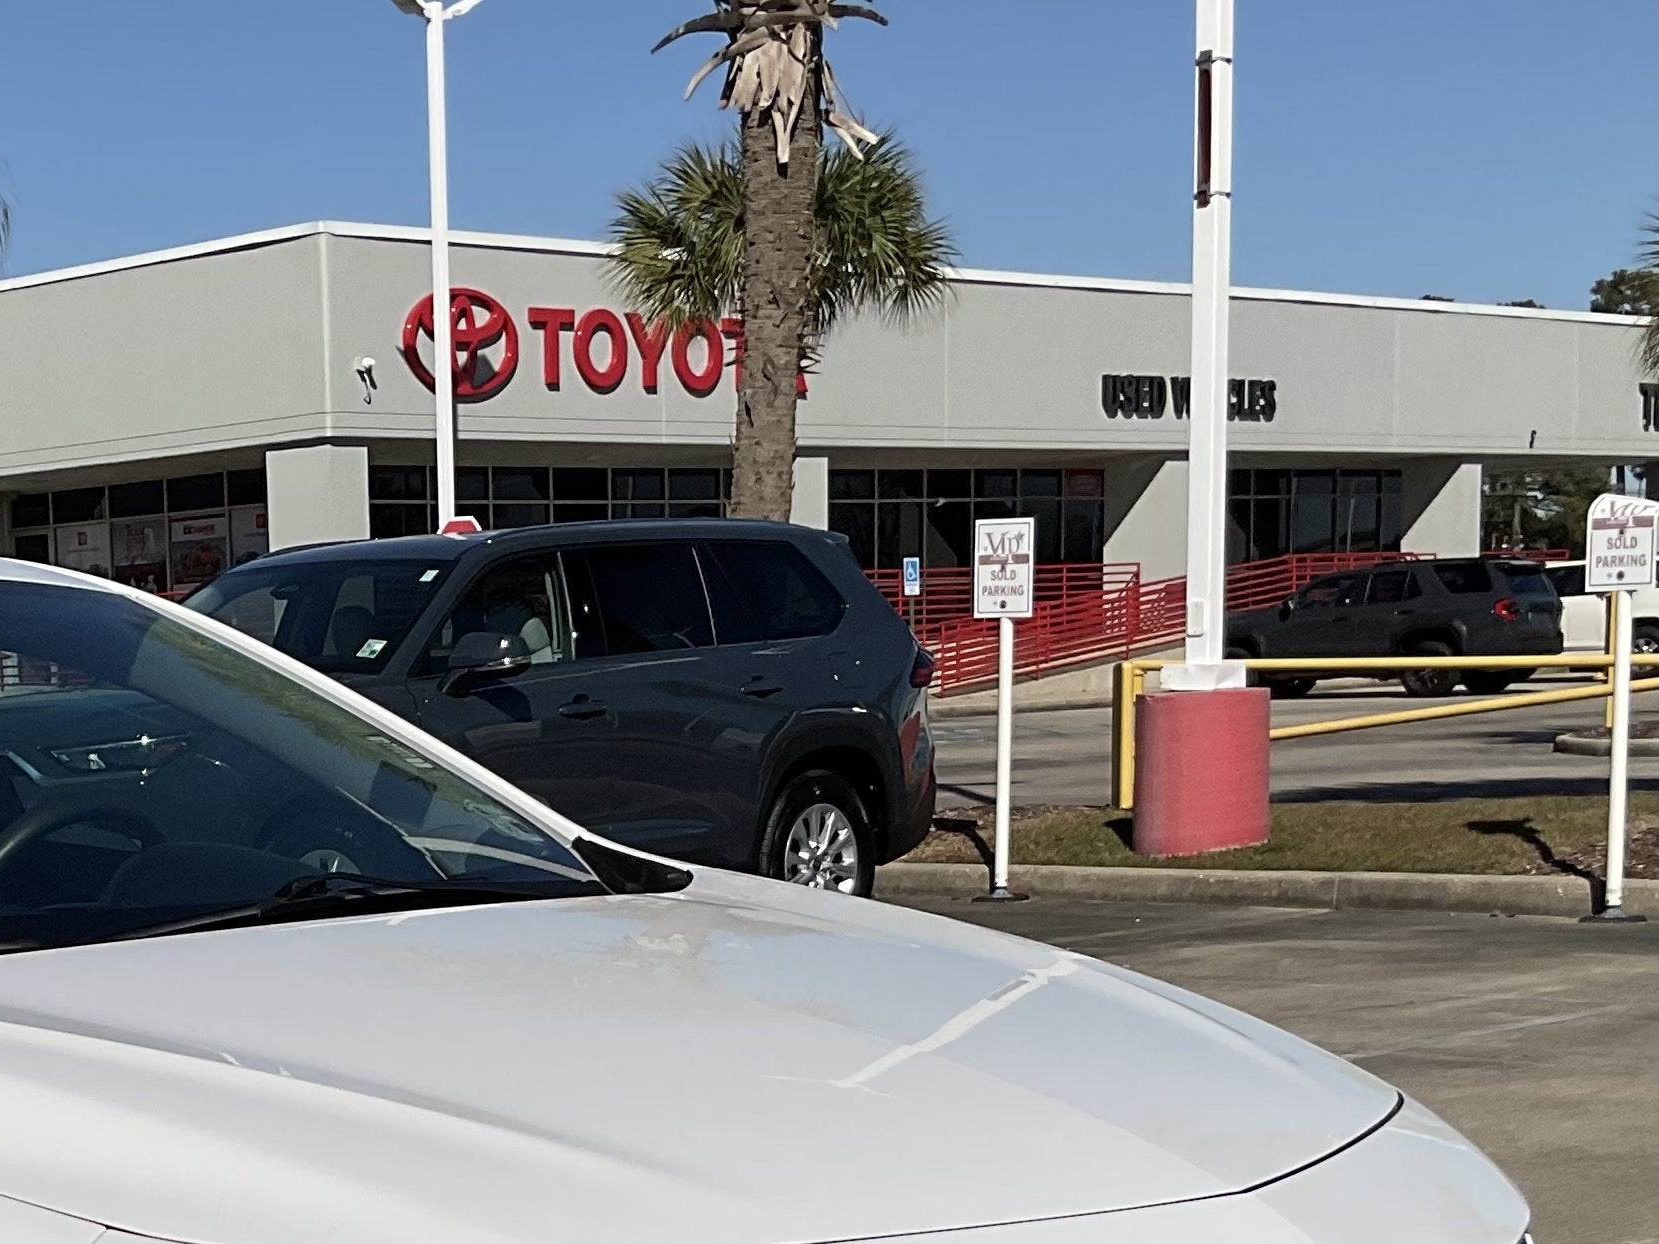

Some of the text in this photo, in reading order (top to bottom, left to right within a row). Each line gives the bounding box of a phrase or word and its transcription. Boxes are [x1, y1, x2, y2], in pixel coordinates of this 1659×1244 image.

[1102, 374, 1167, 419] USED
[1606, 536, 1638, 550] SOLD
[1596, 554, 1647, 568] PARKING
[990, 569, 1017, 581] SOLD
[982, 584, 1025, 596] PARKING
